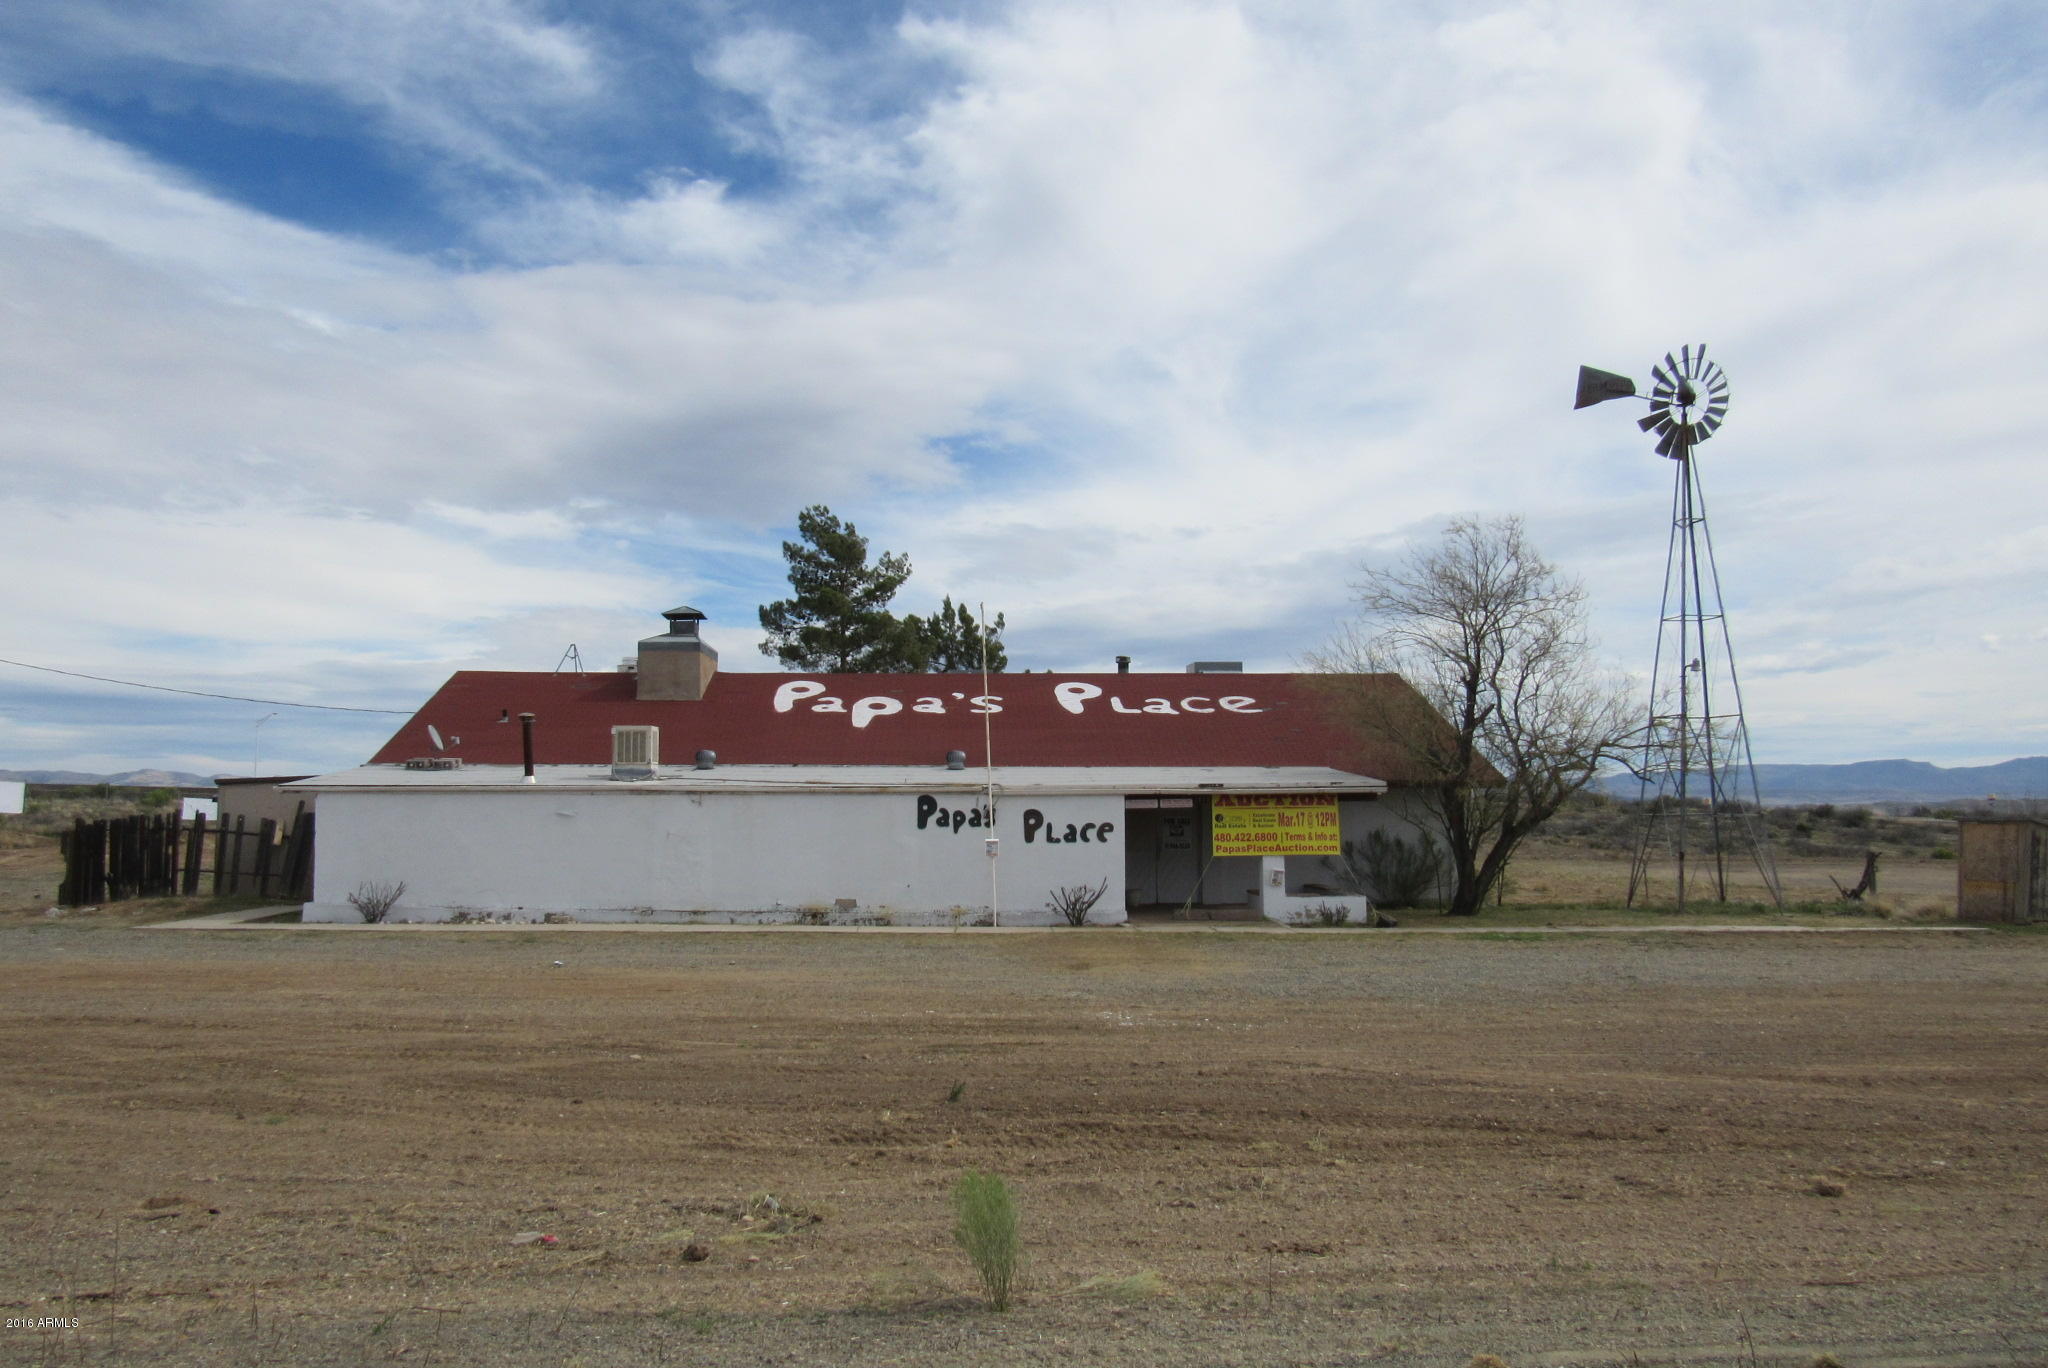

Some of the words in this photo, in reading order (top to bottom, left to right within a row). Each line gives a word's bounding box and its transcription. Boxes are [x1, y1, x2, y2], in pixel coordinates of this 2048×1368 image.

[1315, 812, 1337, 827] 12PM
[1214, 832, 1278, 842] 480.422.6800
[1285, 832, 1306, 841] Terms
[1215, 844, 1338, 854] PapasPlaceAuction.com
